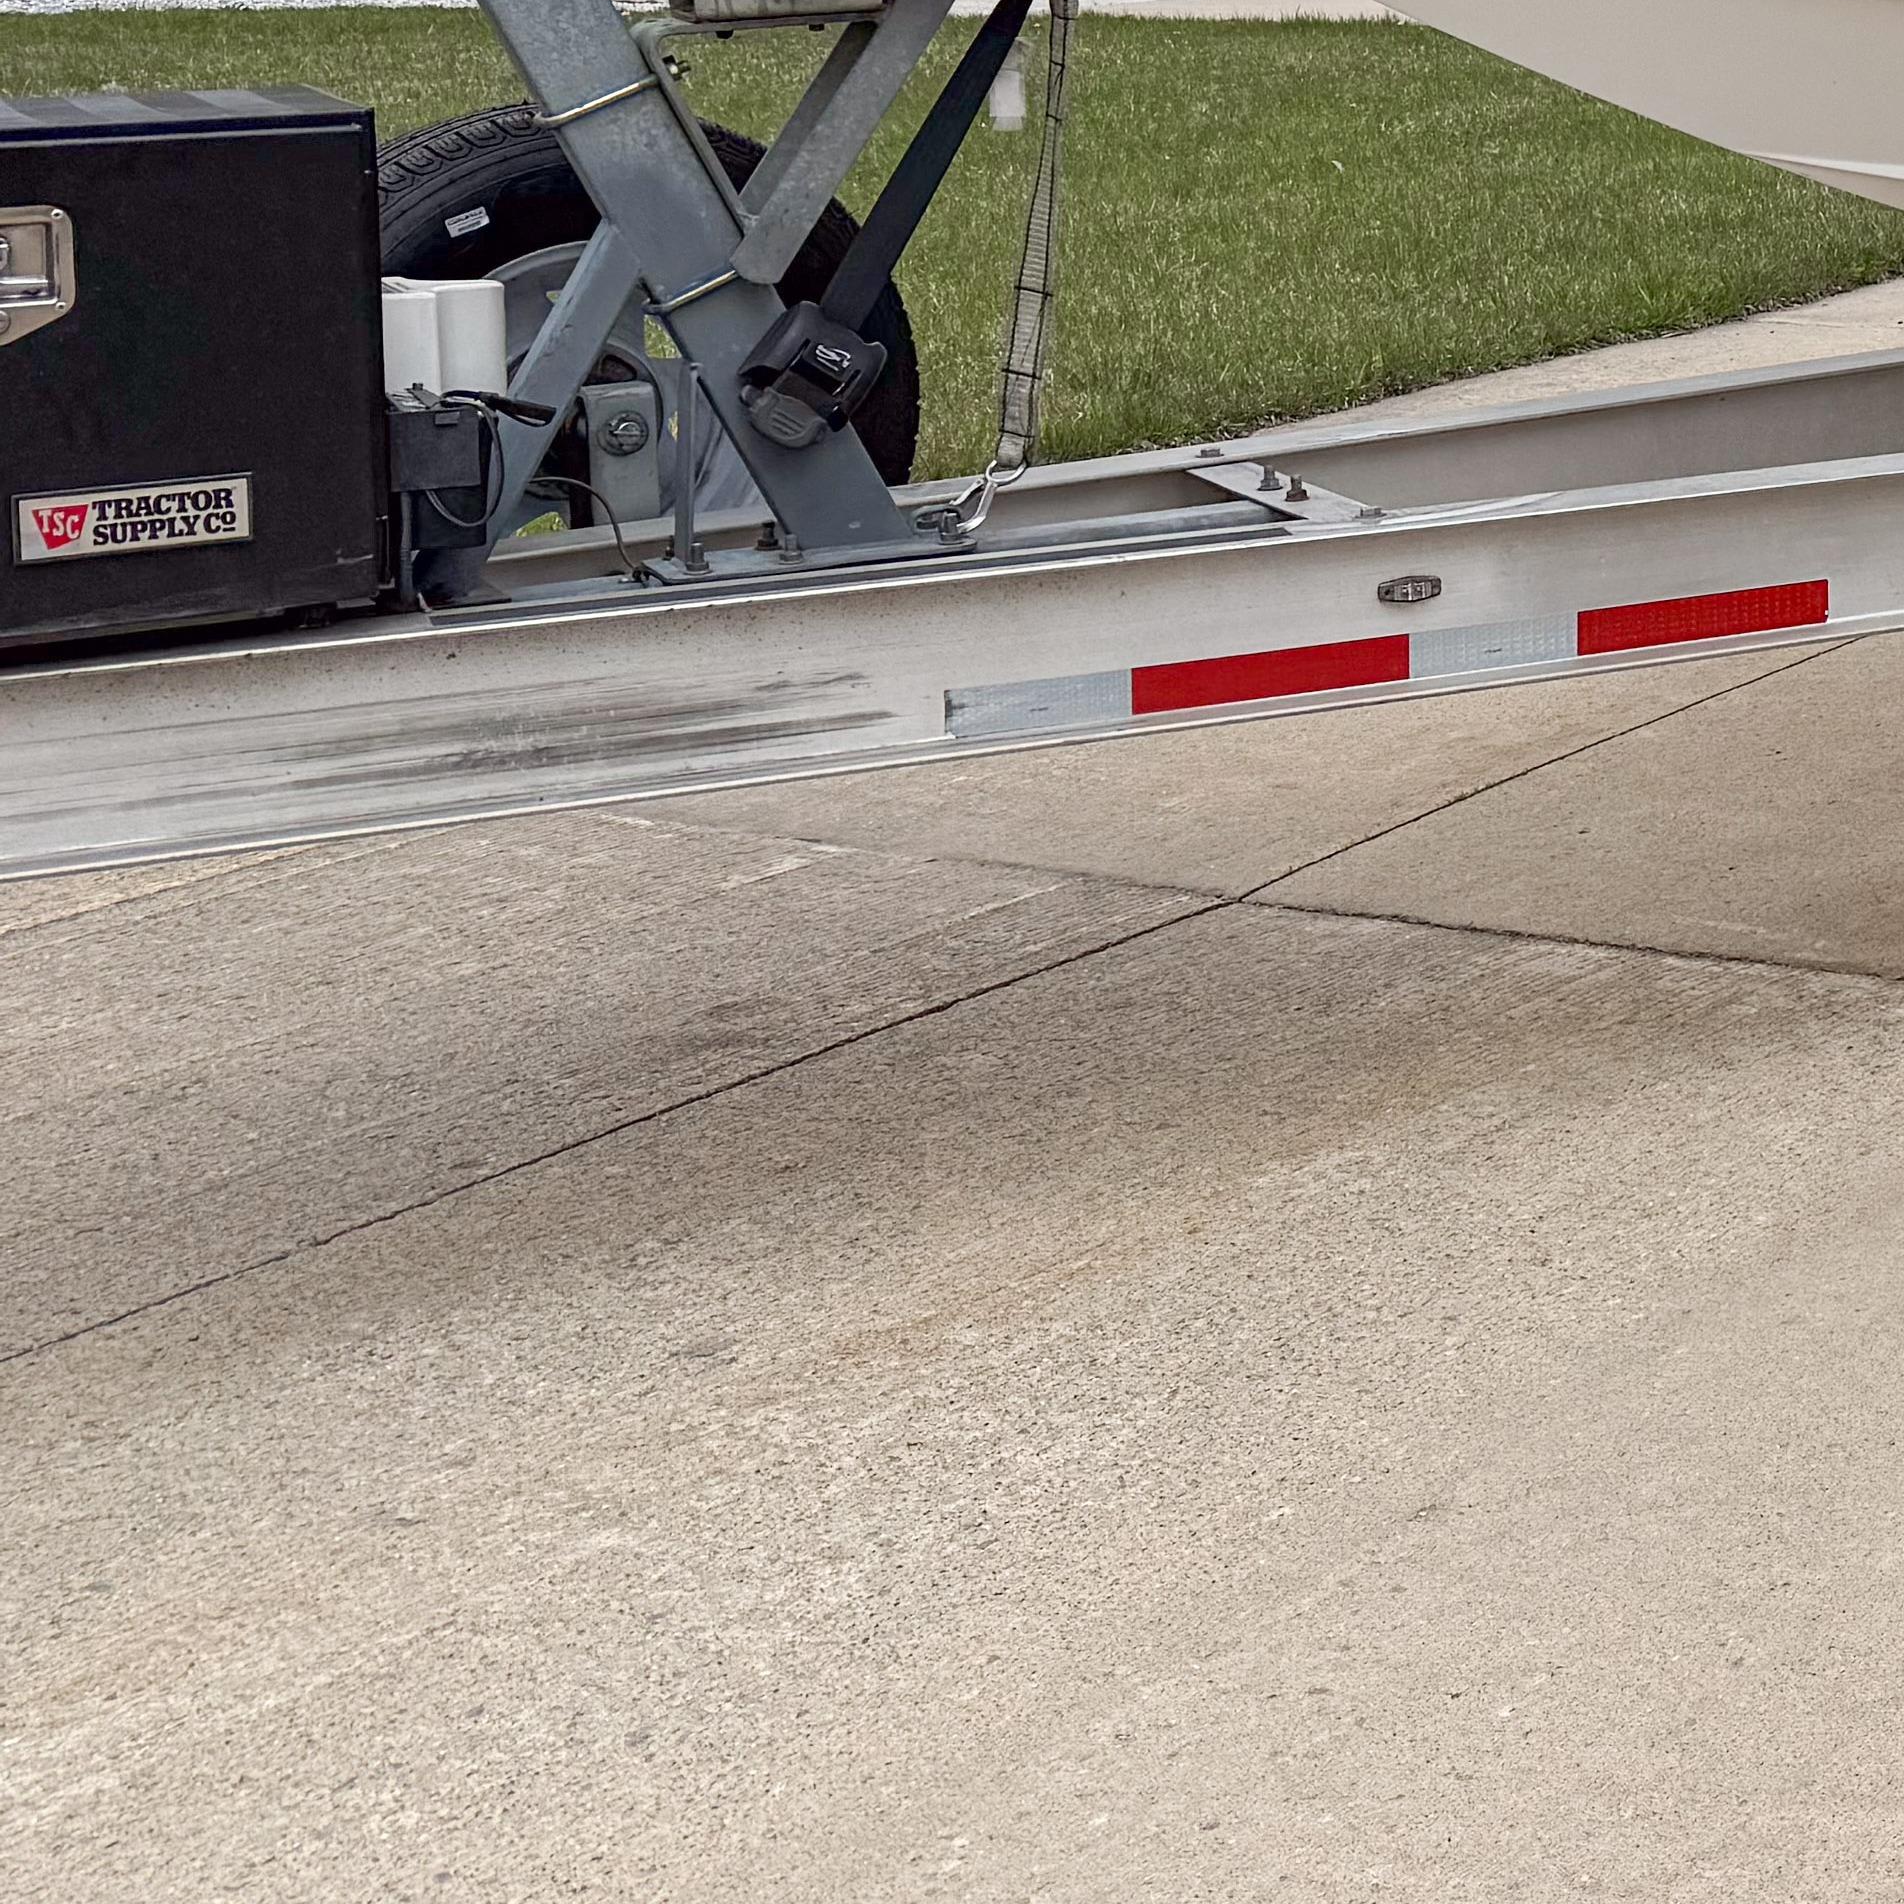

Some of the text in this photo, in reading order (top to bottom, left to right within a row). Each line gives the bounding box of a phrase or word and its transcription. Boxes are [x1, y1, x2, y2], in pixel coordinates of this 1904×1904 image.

[91, 487, 235, 522] TRACTOR
[38, 509, 80, 540] TSC
[92, 516, 198, 546] SUPPLY
